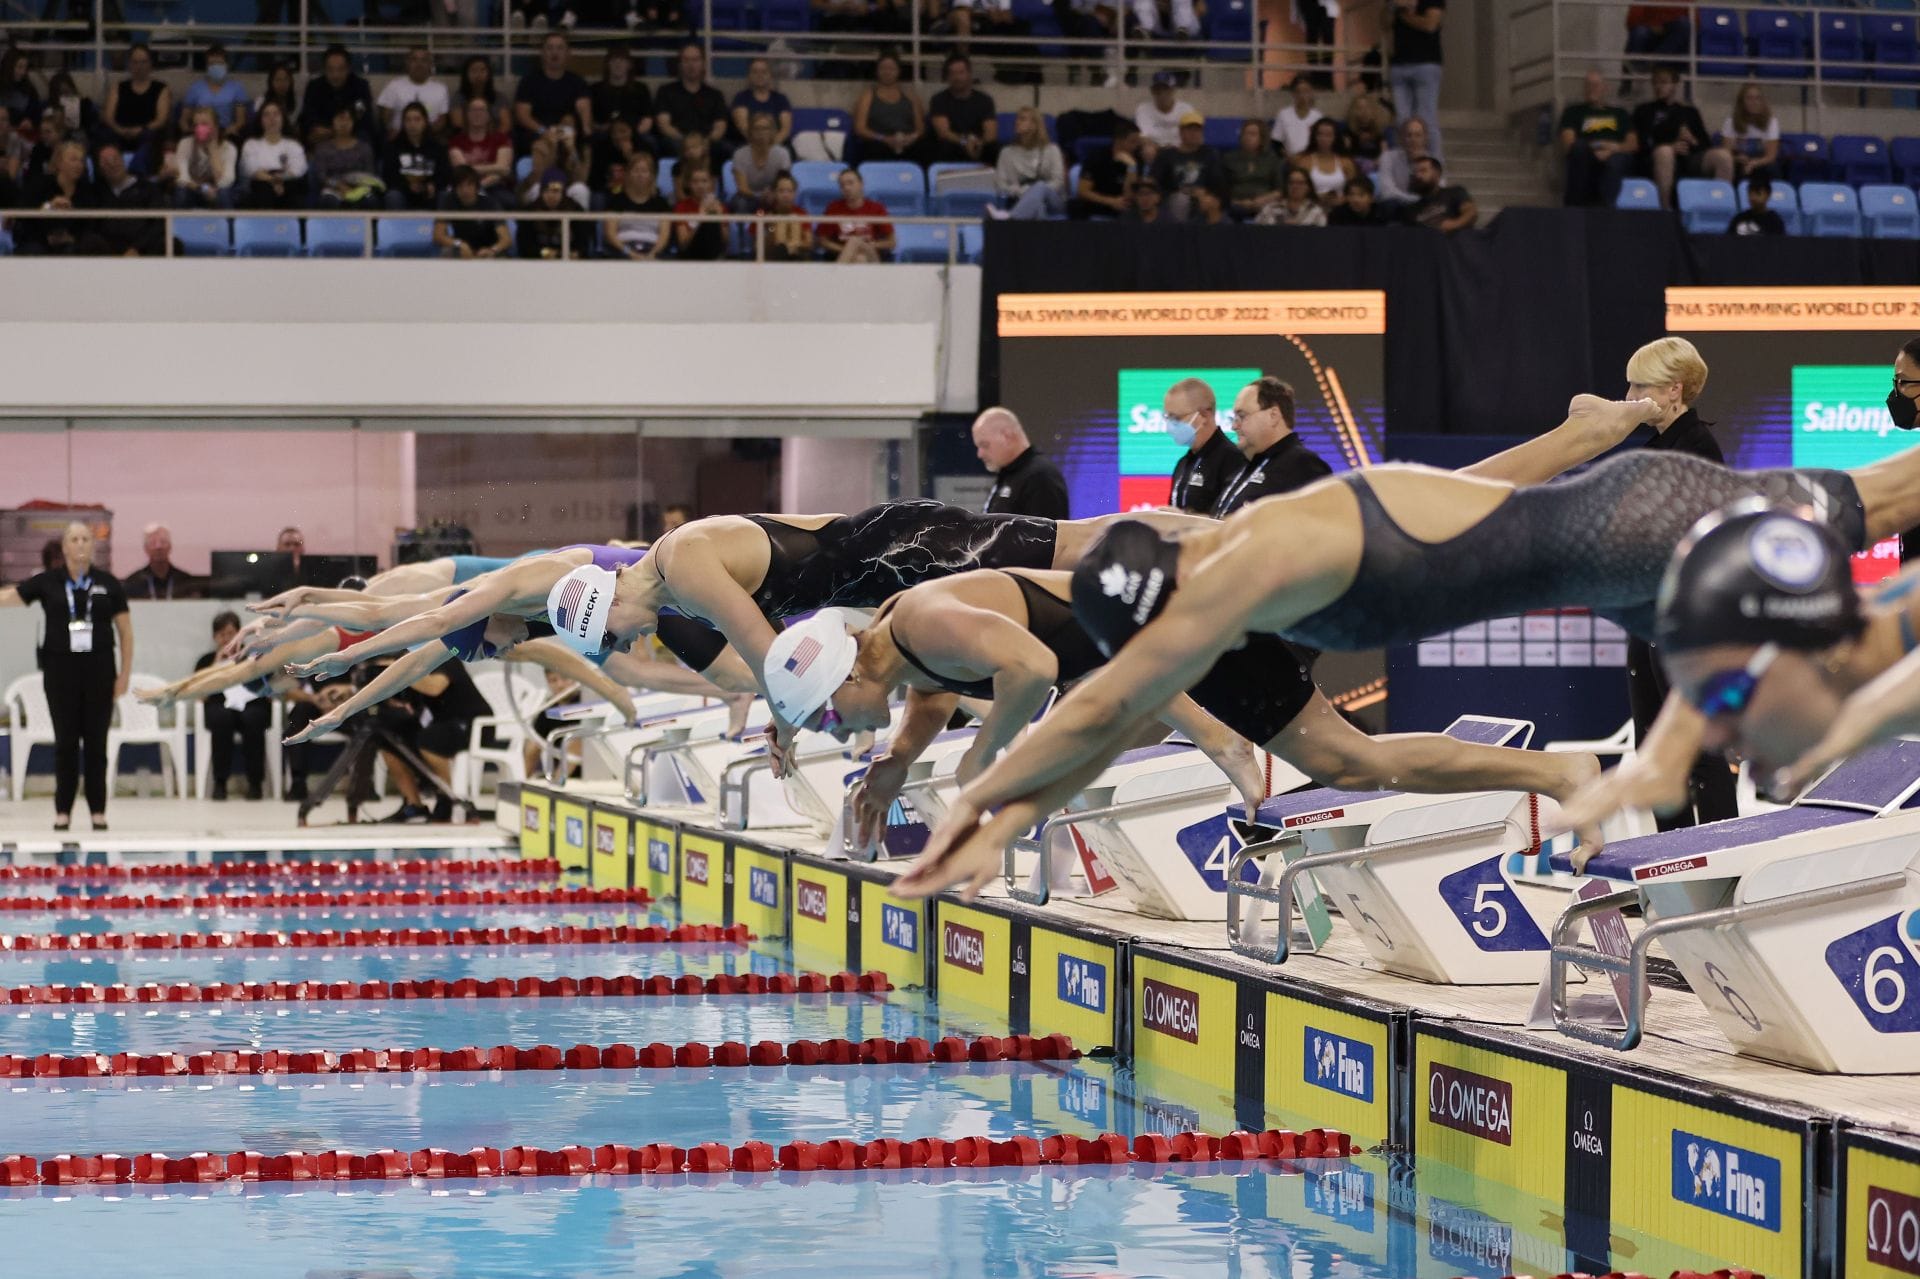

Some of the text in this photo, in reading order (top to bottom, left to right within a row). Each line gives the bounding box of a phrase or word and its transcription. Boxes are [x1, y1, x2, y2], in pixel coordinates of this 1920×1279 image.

[1037, 309, 1127, 322] SWIMMING
[1132, 308, 1192, 321] WORLD
[1196, 308, 1229, 320] CUP
[1233, 307, 1268, 320] 2022
[1287, 306, 1368, 320] TORONTO
[1707, 302, 1801, 316] SWIMMING
[1804, 302, 1868, 315] WORLD
[1872, 302, 1906, 315] CUP
[579, 587, 600, 639] LEDECKY
[1304, 811, 1334, 824] OMEGA
[1204, 835, 1230, 880] 4
[1659, 860, 1695, 875] OMEGA
[1472, 883, 1508, 938] 5
[953, 931, 984, 969] OMEGA
[1704, 961, 1762, 1032] 6
[1864, 945, 1906, 1014] 6
[1156, 992, 1199, 1036] OMEGA
[1240, 1029, 1260, 1050] OMEGA
[1449, 1080, 1511, 1136] OMEGA
[1573, 1130, 1604, 1156] OMEGA
